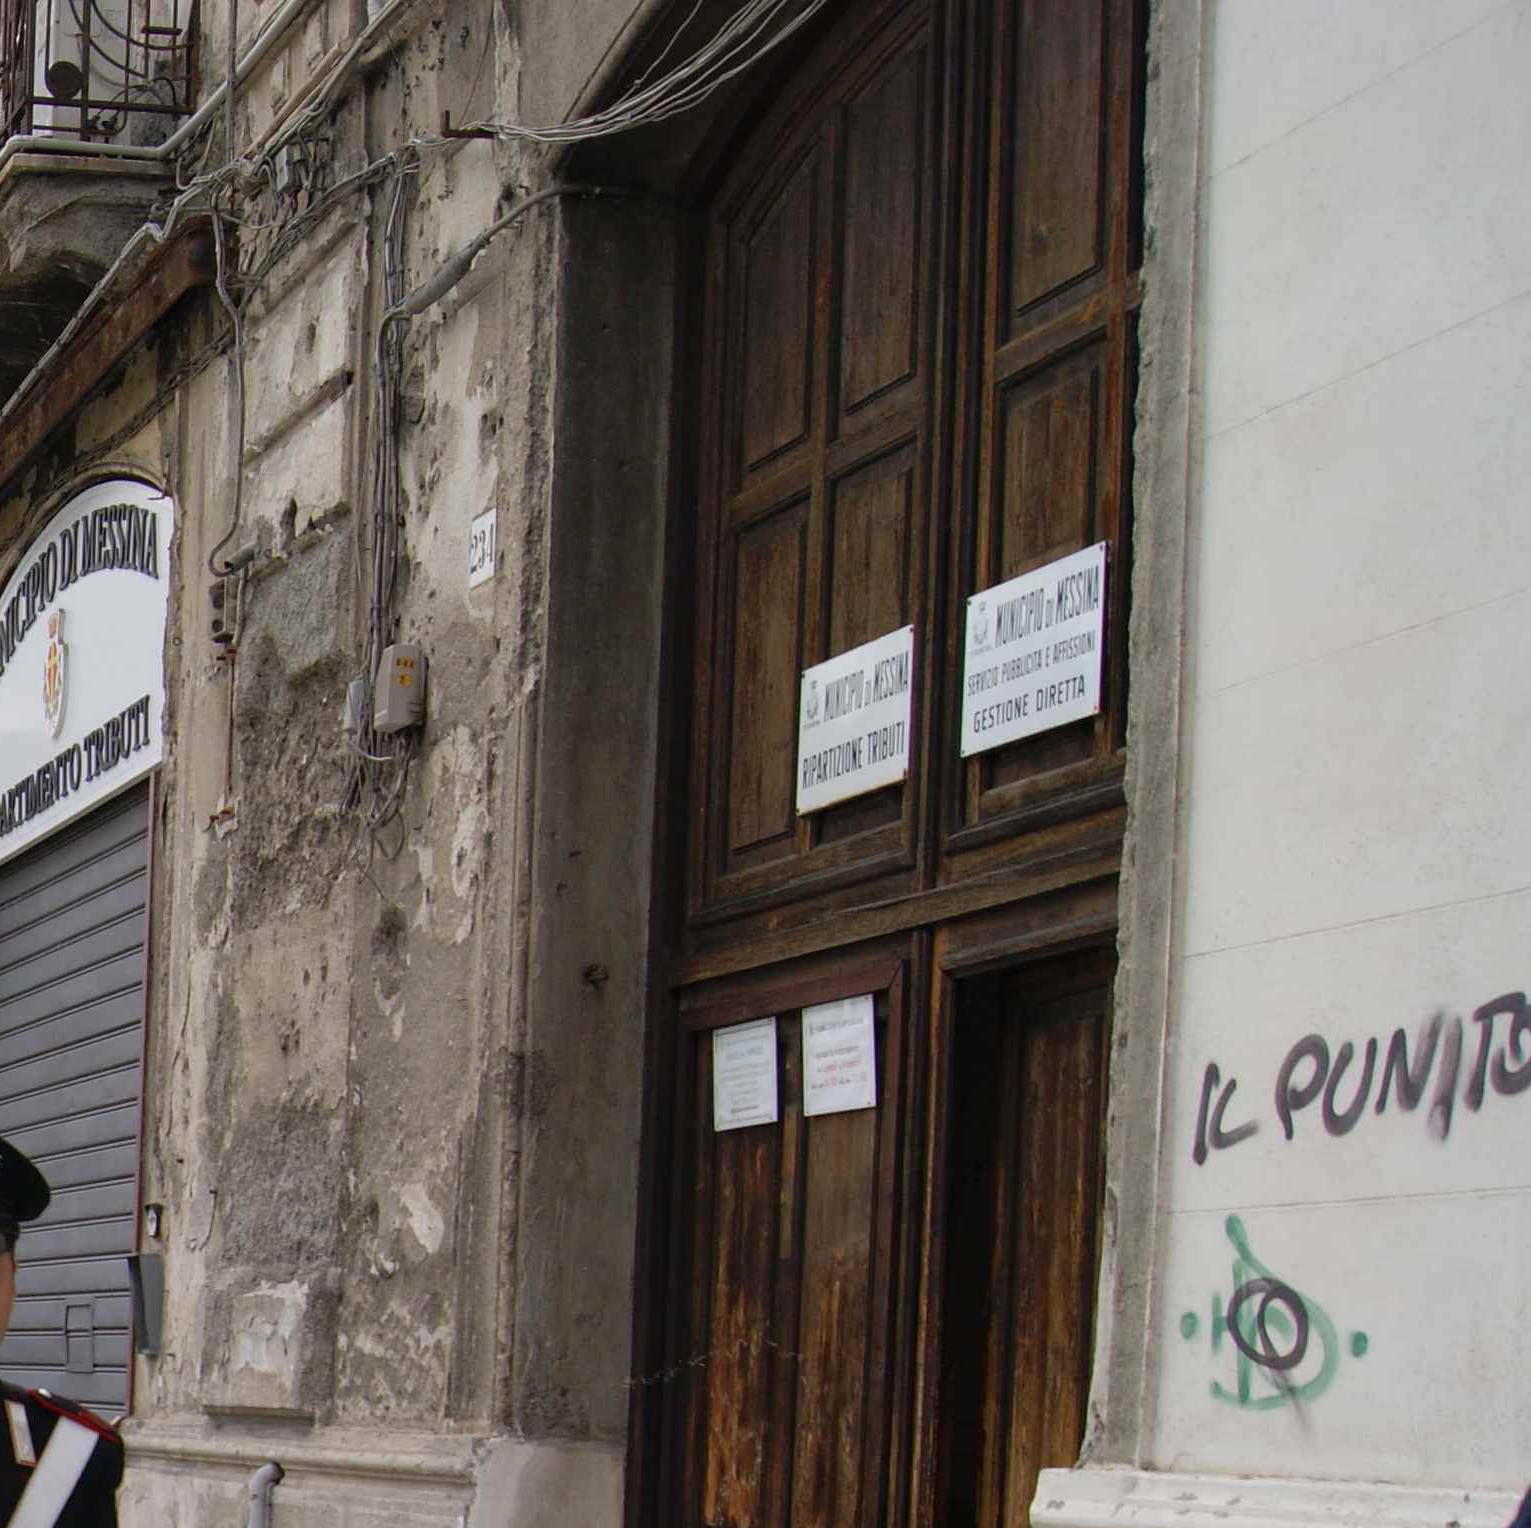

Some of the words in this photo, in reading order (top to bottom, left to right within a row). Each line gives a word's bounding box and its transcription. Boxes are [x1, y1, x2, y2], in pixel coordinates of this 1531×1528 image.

[59, 519, 79, 591] DI
[80, 503, 158, 579] MESSINA
[470, 523, 494, 574] 234
[996, 587, 1044, 648] MUNICIPIO
[1055, 566, 1099, 624] MESSINA
[824, 669, 864, 722] MUNICIPIO
[873, 651, 909, 702] MESSINA
[968, 666, 998, 696] SERVIZIO
[1045, 646, 1050, 667] E
[1053, 629, 1095, 663] AFFISSIONI
[84, 695, 150, 782] TRIBUTI
[973, 693, 1028, 733] GESTIONE
[1036, 674, 1085, 712] DIRETTA
[802, 736, 863, 790] RIPARTIZIONE
[867, 719, 905, 766] TRIBUTI
